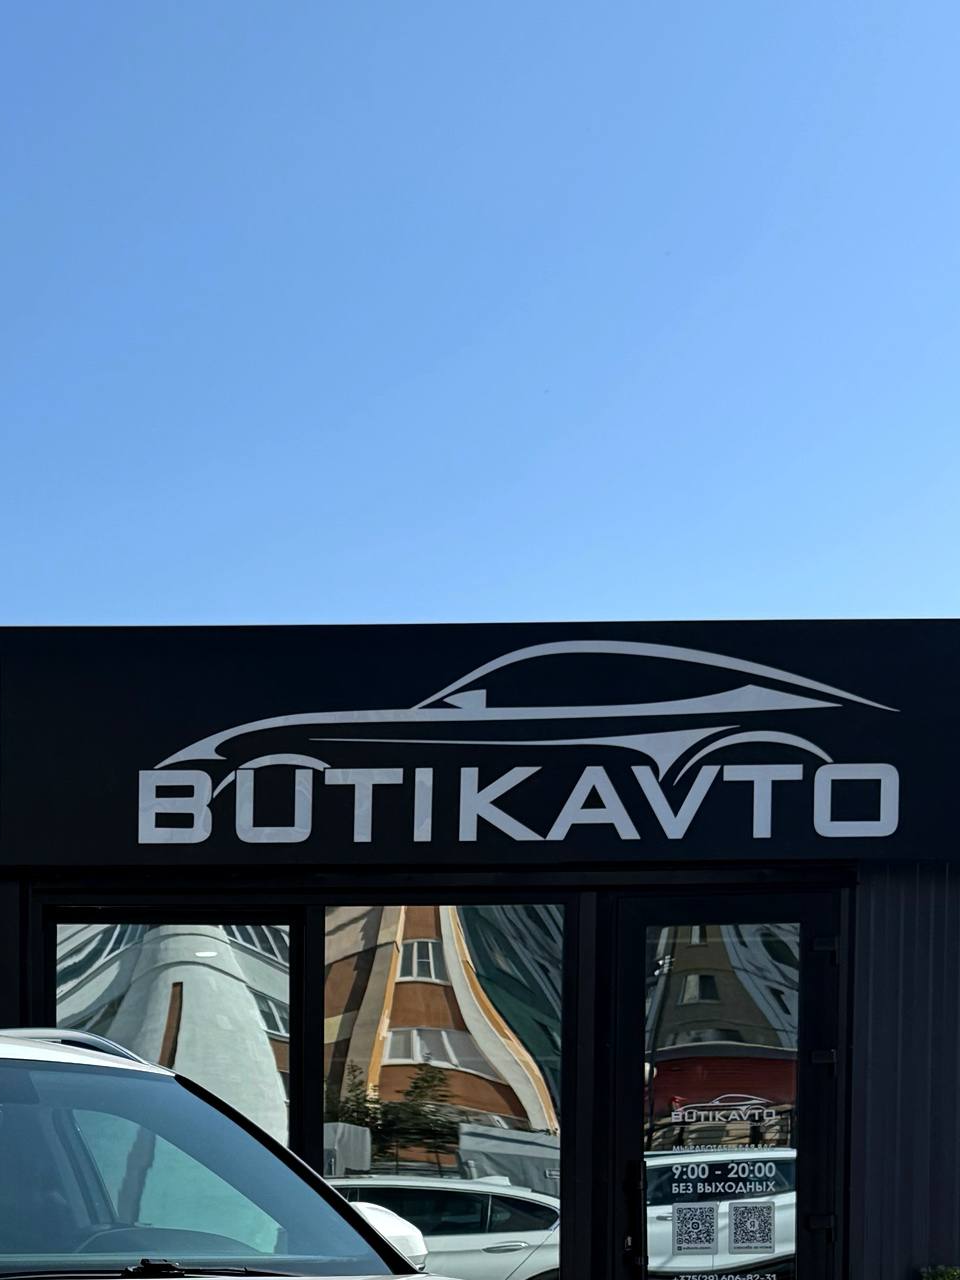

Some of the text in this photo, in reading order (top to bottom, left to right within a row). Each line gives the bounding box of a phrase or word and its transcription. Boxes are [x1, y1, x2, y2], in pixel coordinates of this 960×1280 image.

[138, 763, 900, 844] BUTIKAVTO
[671, 1109, 776, 1122] BUTIKAVTO
[672, 1164, 709, 1179] 9:00
[728, 1162, 776, 1178] 20:00
[672, 1181, 776, 1194] БЕЗ ВЫХОДНЫХ
